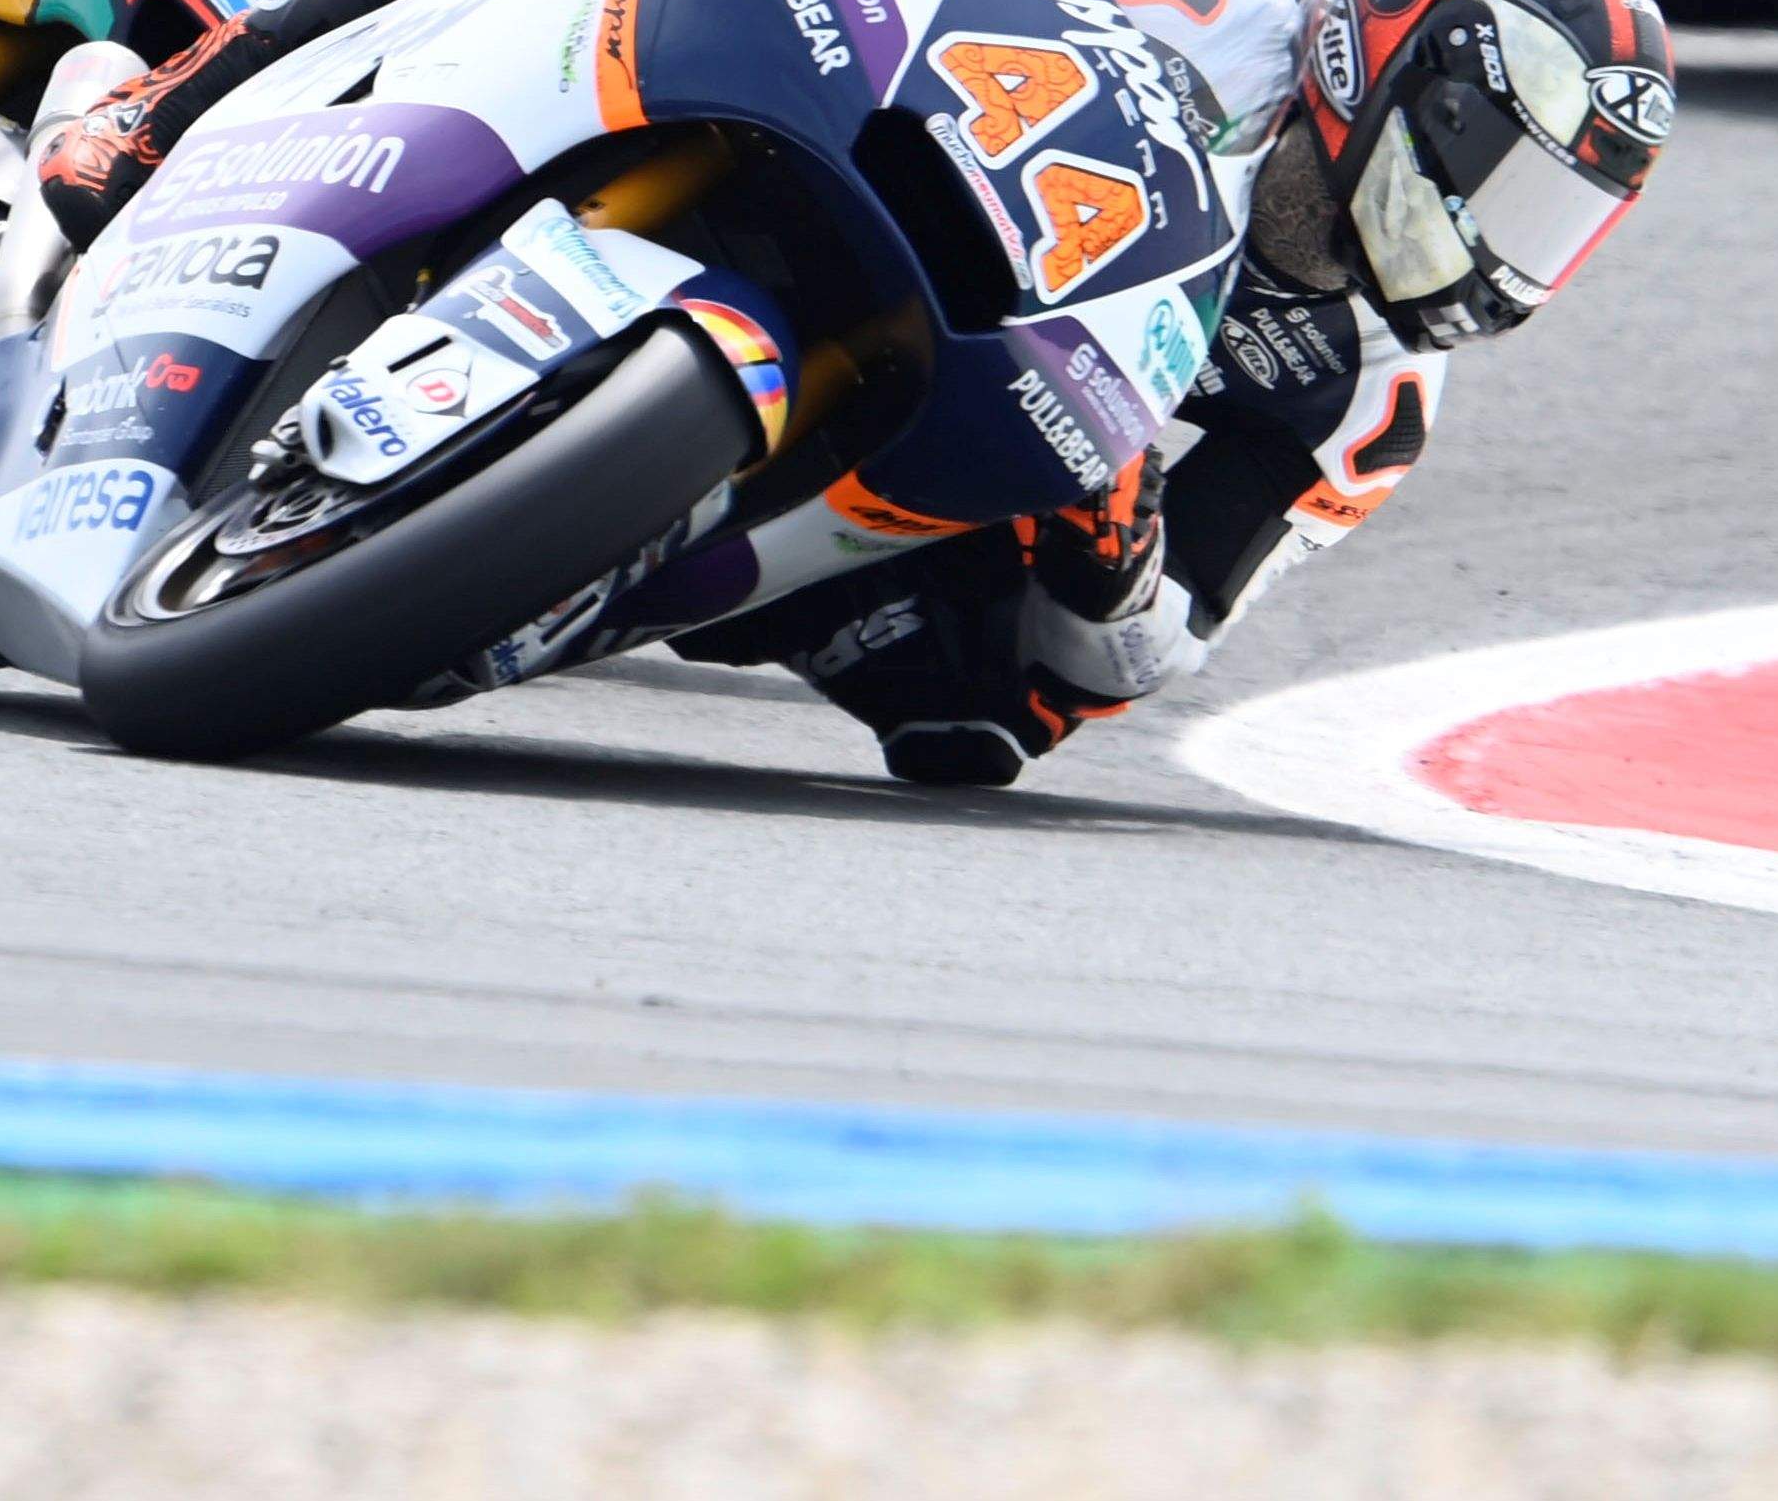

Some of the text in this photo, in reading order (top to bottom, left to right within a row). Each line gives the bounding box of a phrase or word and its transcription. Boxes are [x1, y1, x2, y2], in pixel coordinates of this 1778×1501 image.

[194, 116, 406, 194] solunion
[926, 30, 1151, 304] 44
[1249, 307, 1317, 387] PULL&BEAR
[1006, 368, 1110, 491] PULL&BEAR
